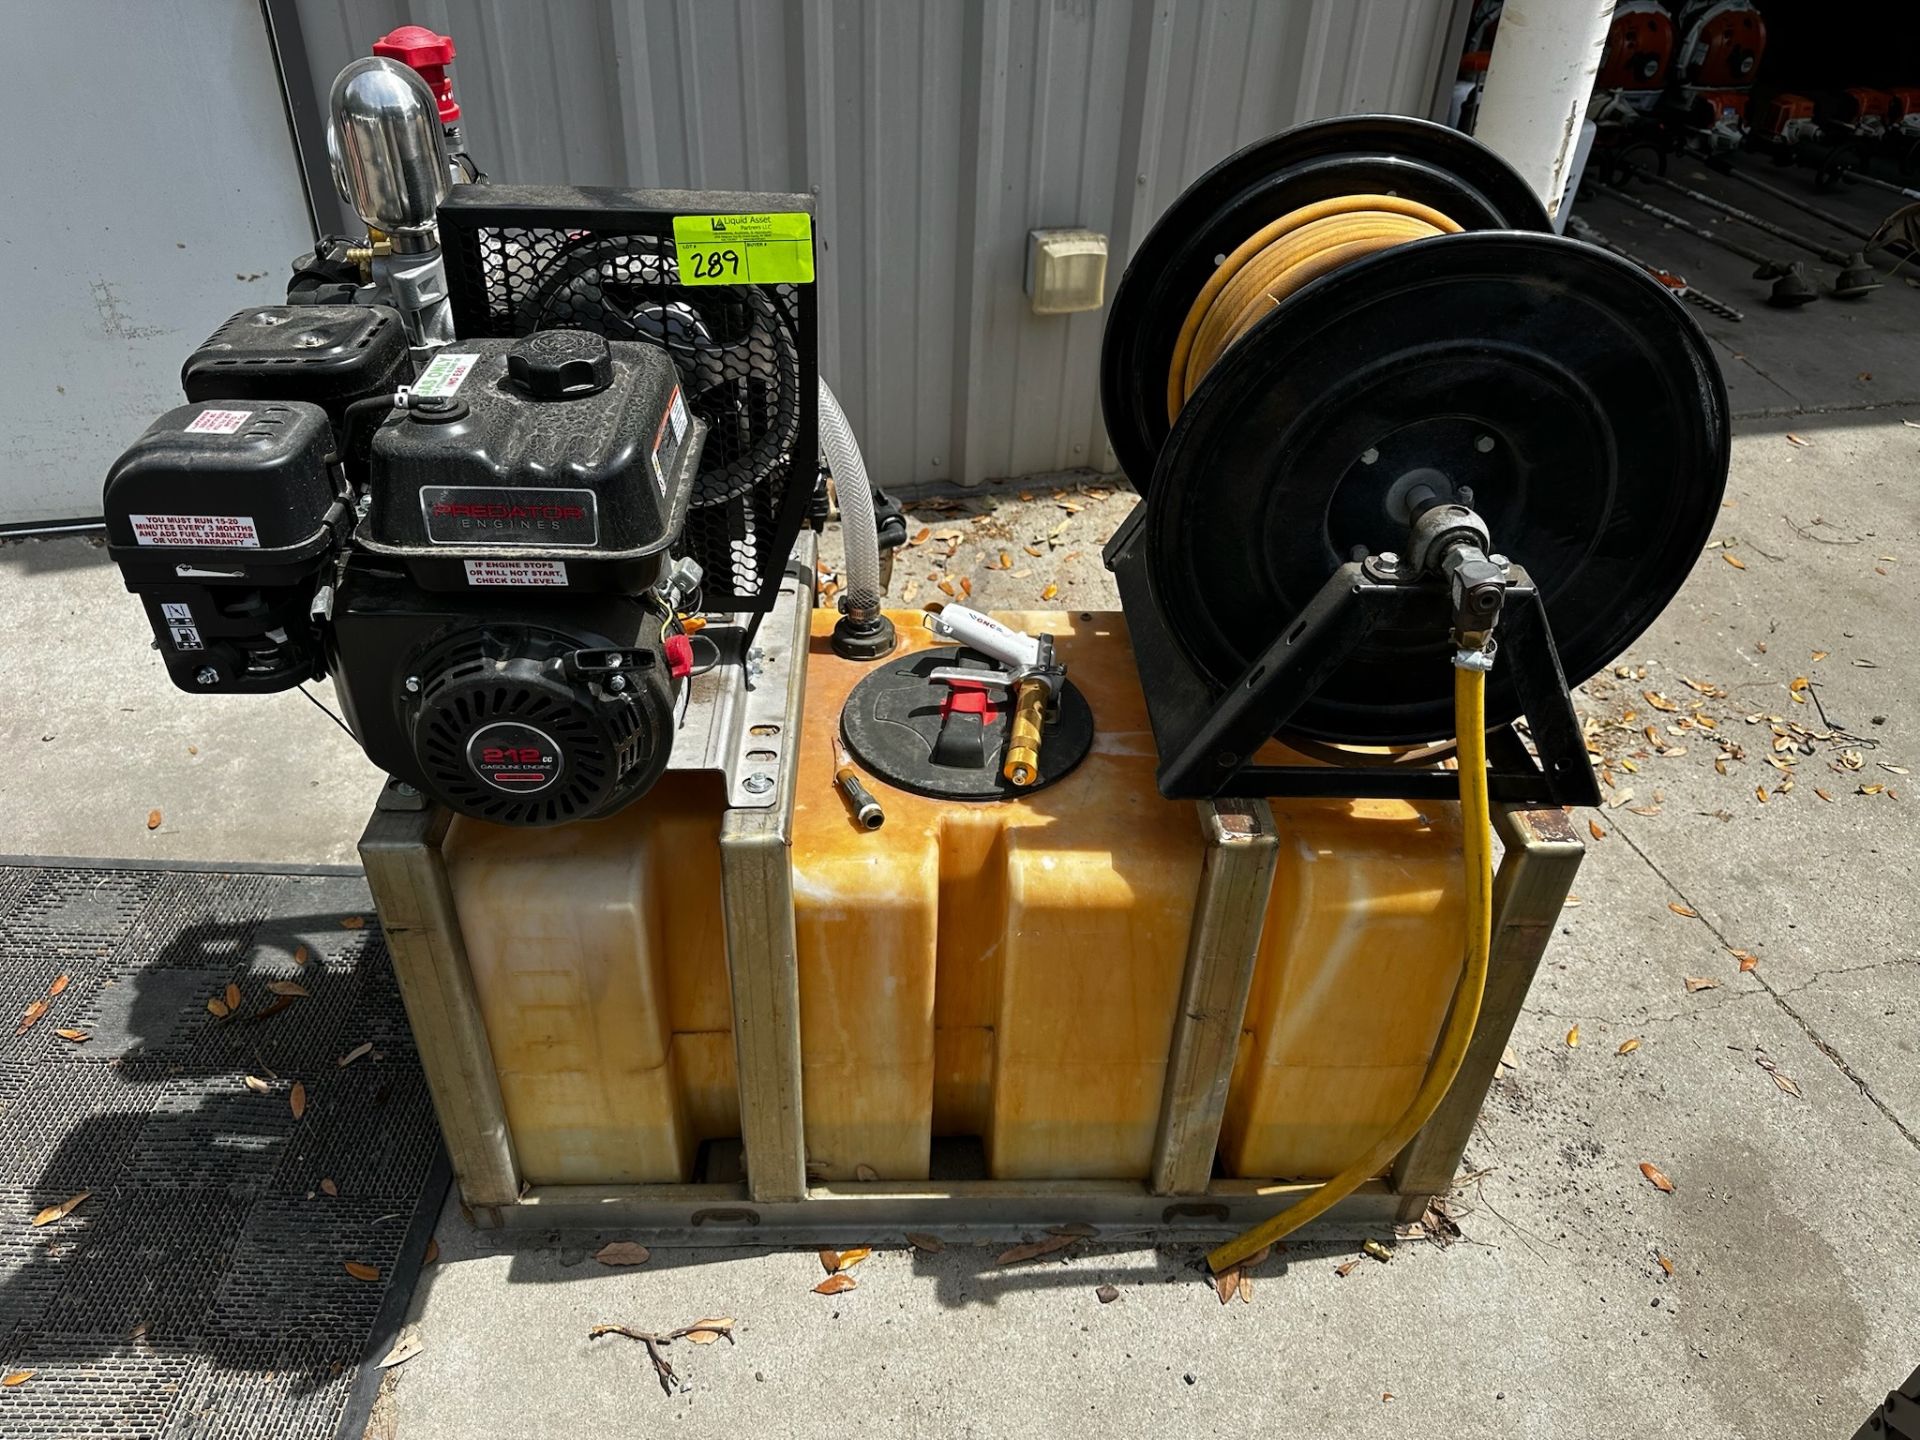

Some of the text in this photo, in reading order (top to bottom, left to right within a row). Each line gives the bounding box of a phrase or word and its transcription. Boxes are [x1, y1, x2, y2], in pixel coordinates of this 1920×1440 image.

[724, 217, 748, 226] Liquid
[690, 250, 738, 278] 289
[427, 358, 453, 378] ONLY
[433, 502, 586, 520] PREDATOR
[462, 519, 560, 529] ENGINES
[482, 748, 541, 763] 212
